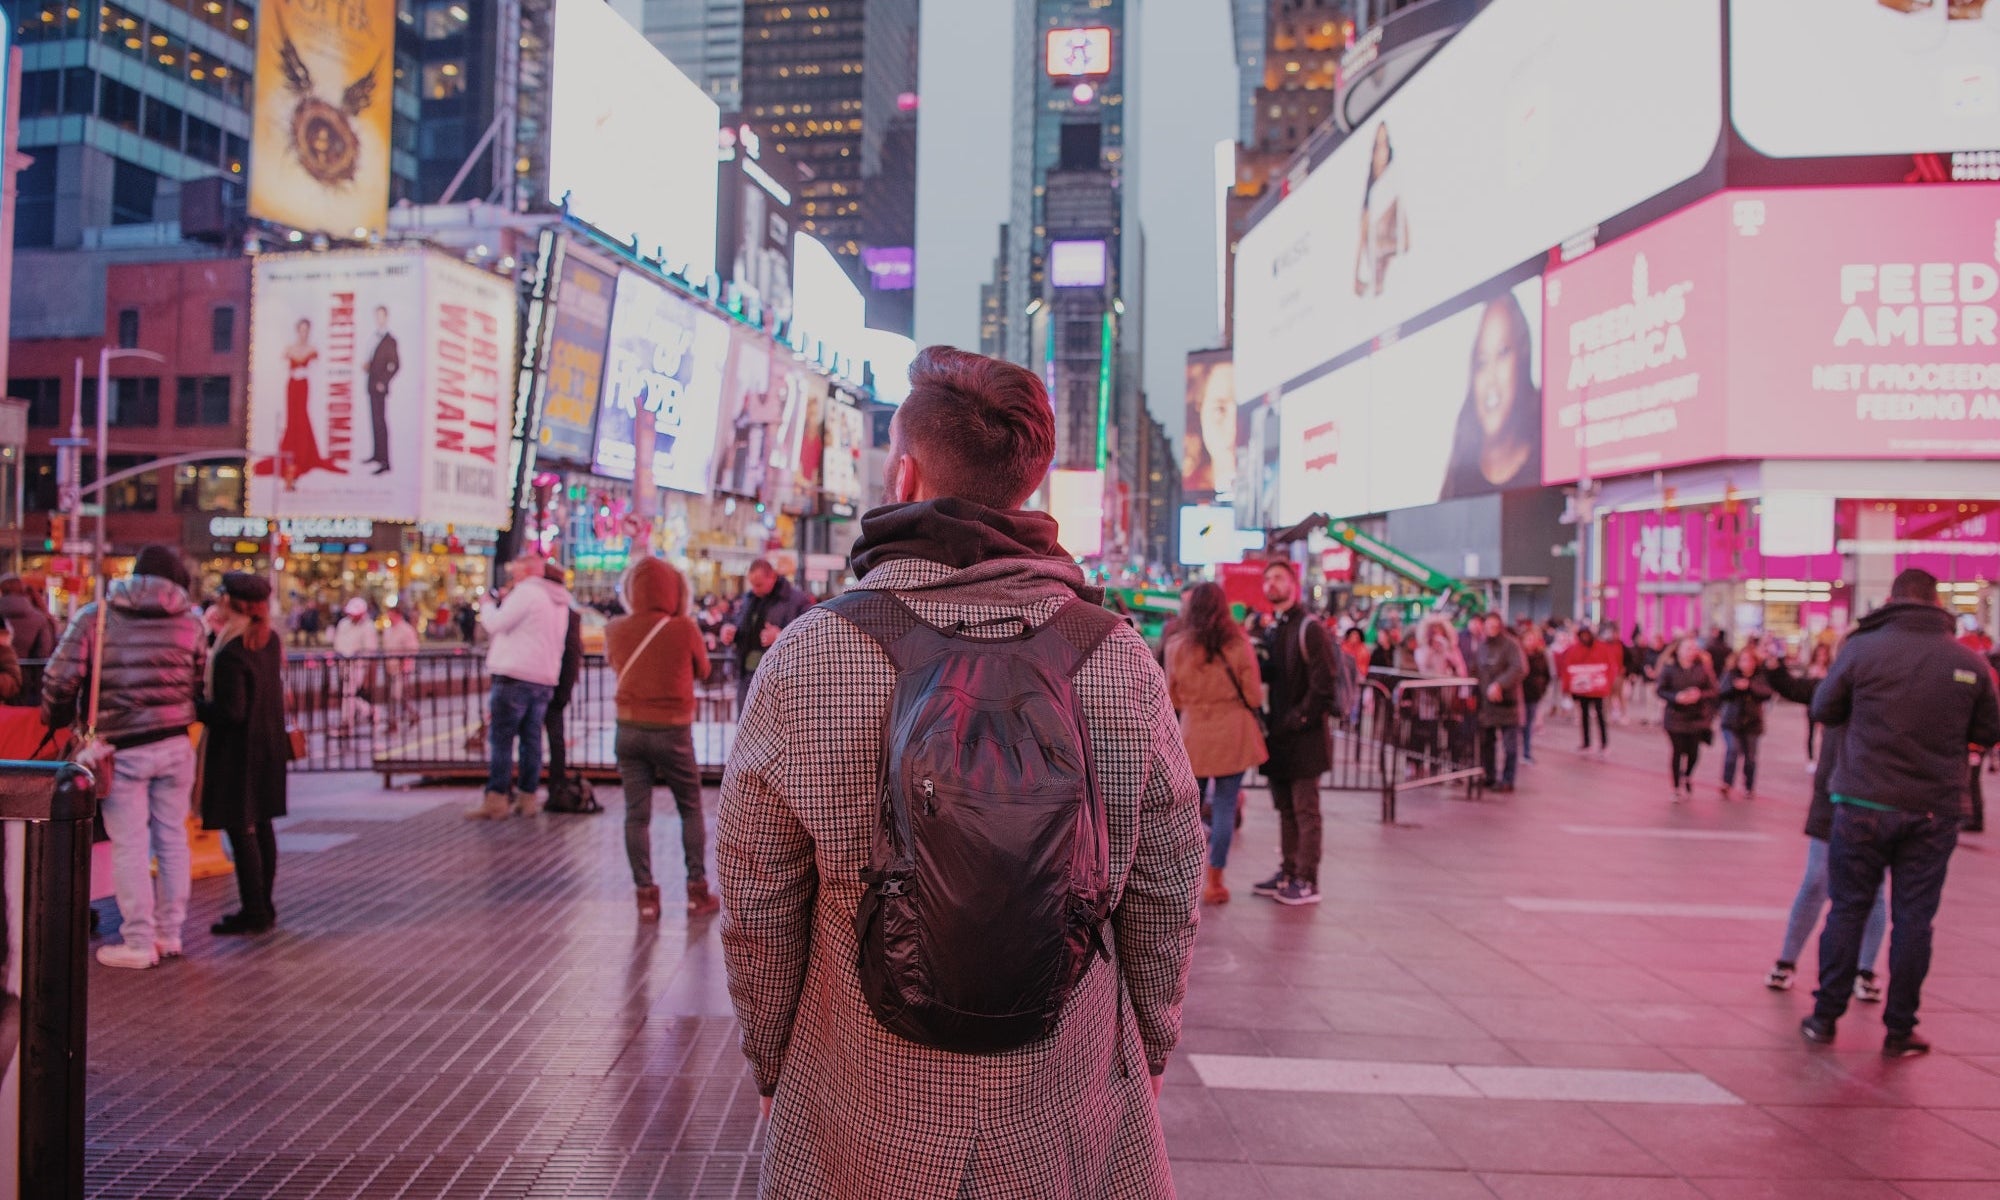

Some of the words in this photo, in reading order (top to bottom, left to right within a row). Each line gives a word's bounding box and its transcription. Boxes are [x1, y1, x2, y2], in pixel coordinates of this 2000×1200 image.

[1840, 262, 1999, 305] FEED
[1568, 284, 1687, 357] FEEDING
[1833, 305, 1999, 347] AMER
[435, 302, 468, 455] WOMAN
[469, 309, 499, 465] PRETTY
[1812, 363, 1865, 392] NET
[1855, 392, 1967, 421] FEEDING
